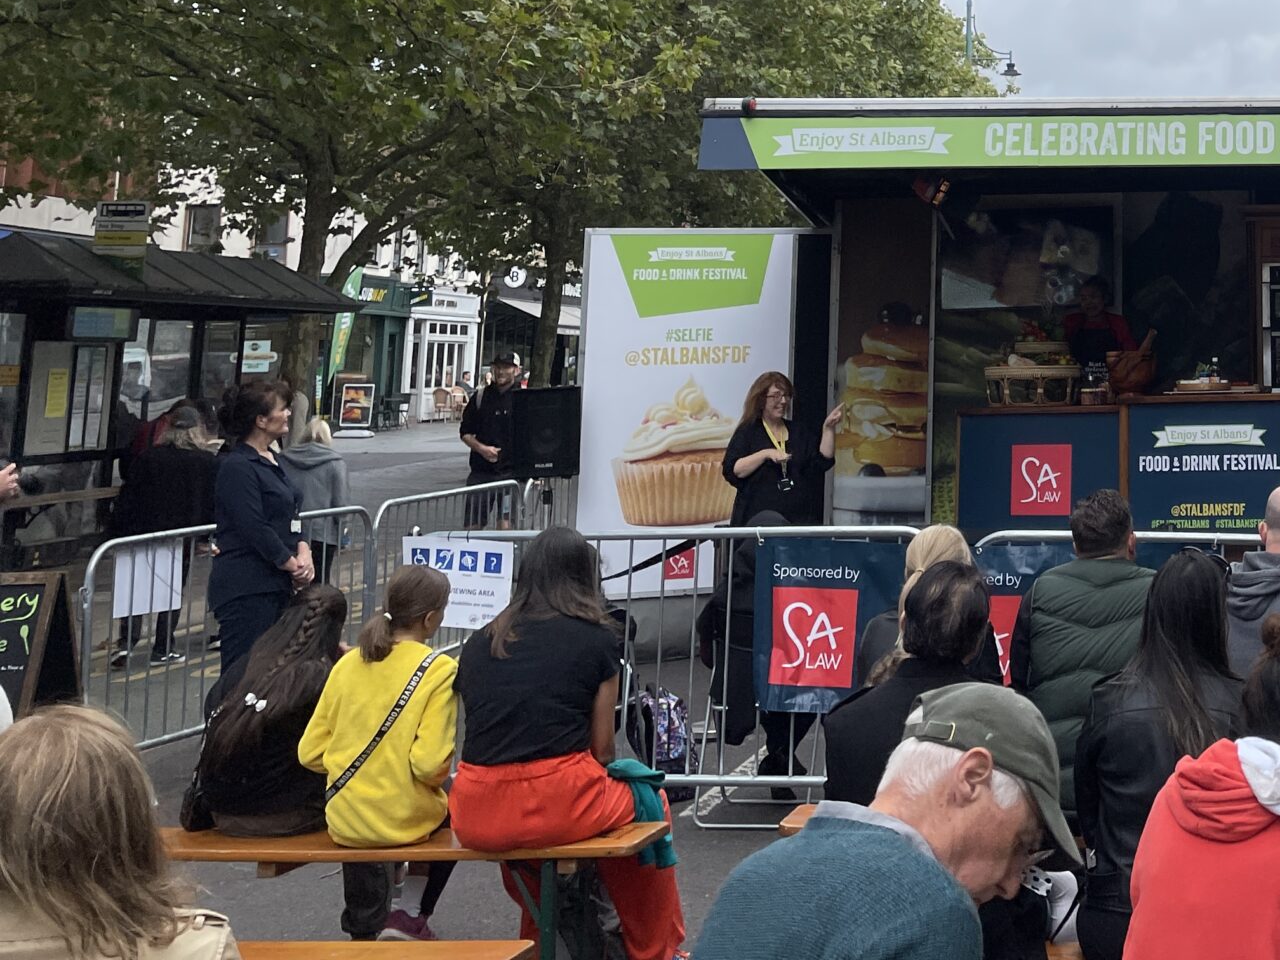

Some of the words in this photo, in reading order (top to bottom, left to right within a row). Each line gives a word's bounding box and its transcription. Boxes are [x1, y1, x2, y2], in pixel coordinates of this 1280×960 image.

[799, 133, 844, 150] Enjoy
[850, 132, 865, 147] St
[869, 131, 926, 146] Albans
[985, 121, 1186, 157] CELEBRATING
[1199, 120, 1275, 155] FOOD
[660, 249, 683, 260] Enjoy
[684, 248, 694, 258] St
[695, 248, 724, 258] Albans
[633, 269, 660, 281] FOOD
[661, 269, 668, 280] &
[669, 268, 700, 280] DRINK
[702, 267, 748, 280] FESTIVAL
[665, 328, 714, 342] #SELFIE
[624, 345, 752, 367] @STALBANSFDF
[1170, 430, 1199, 442] Enjoy
[1200, 429, 1211, 439] St
[1213, 428, 1248, 439] Albans
[1139, 455, 1170, 472] FOOD
[1172, 456, 1180, 472] &
[1182, 454, 1220, 471] DRINK
[1223, 453, 1280, 470] FESTIVAL
[1020, 456, 1062, 503] SA
[1037, 491, 1062, 503] LAW
[1170, 503, 1246, 517] @STALBANSFDF
[772, 563, 844, 582] Sponsored
[845, 566, 861, 582] by
[1005, 573, 1022, 587] by
[478, 589, 495, 597] AREA
[781, 601, 844, 669] SA
[805, 652, 843, 671] LAW
[399, 670, 423, 706] FOREVER
[381, 707, 401, 732] YOUNG
